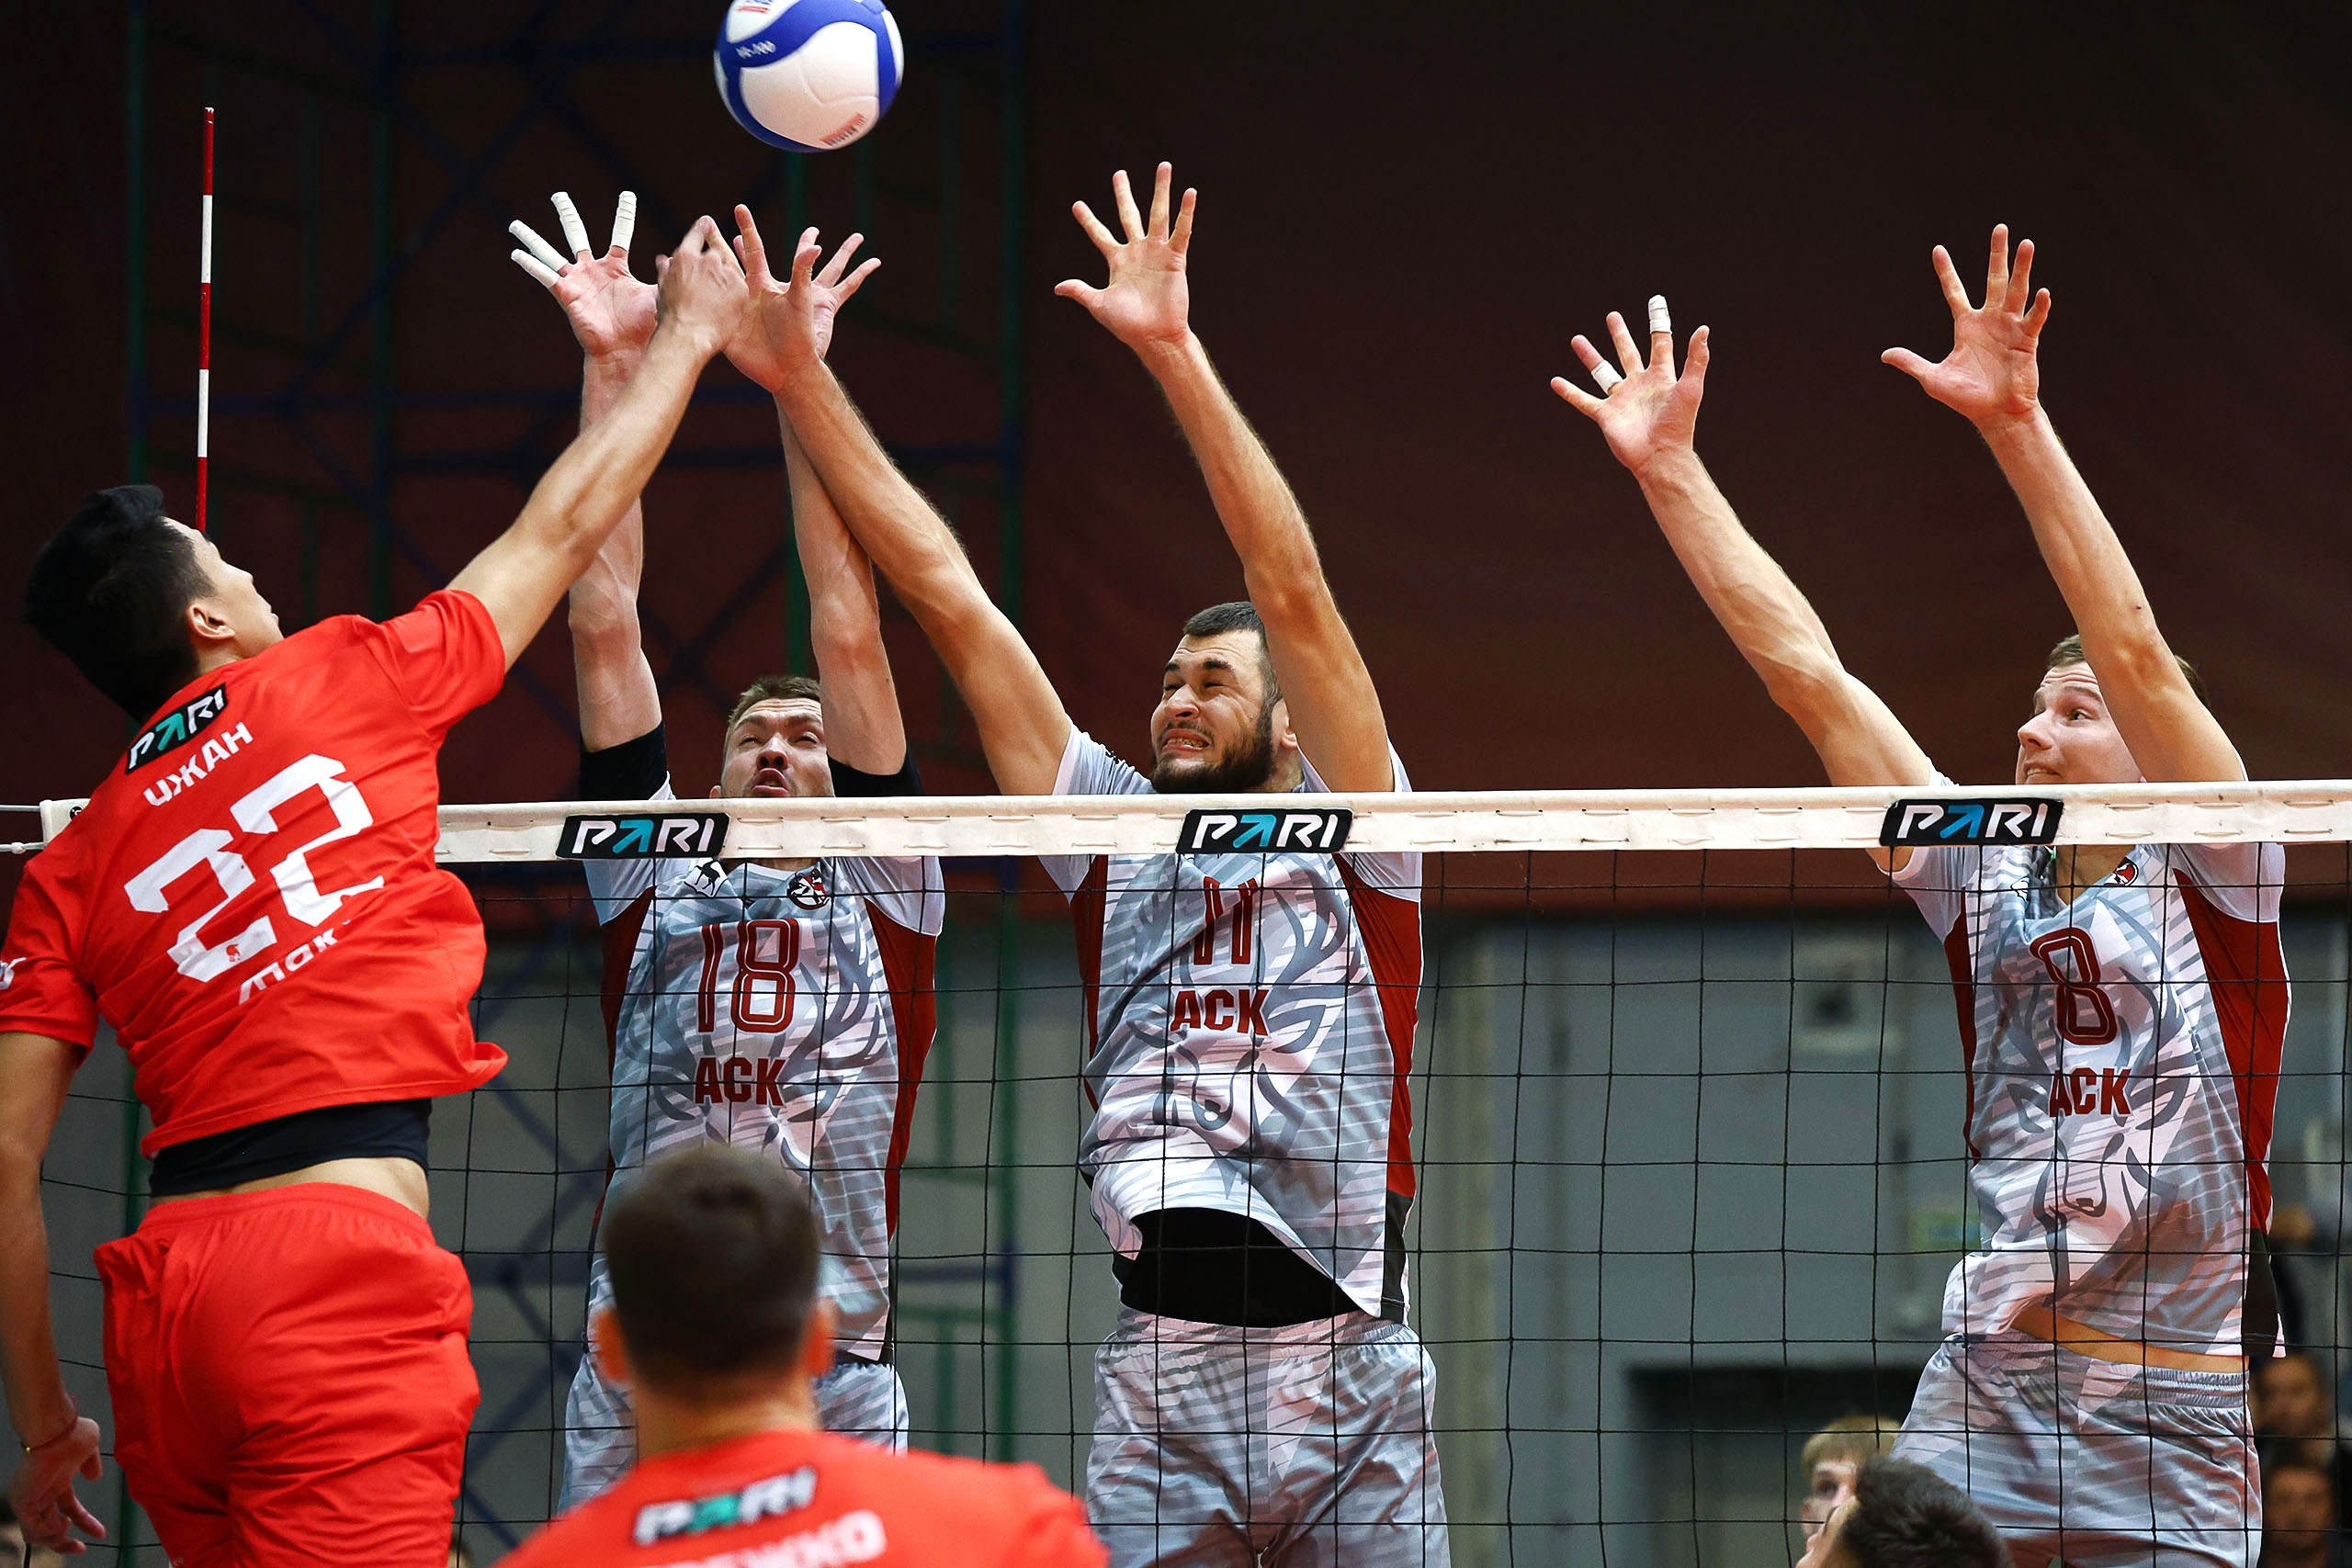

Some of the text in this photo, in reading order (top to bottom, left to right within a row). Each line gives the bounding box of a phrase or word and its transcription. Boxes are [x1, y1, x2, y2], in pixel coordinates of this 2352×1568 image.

[129, 689, 224, 769] PARI
[571, 818, 715, 854] PARI
[1192, 814, 1339, 849] PARI
[1896, 803, 2049, 840] PARI
[124, 753, 384, 982] 22
[697, 919, 800, 1034] 18
[2029, 927, 2117, 1045] 8
